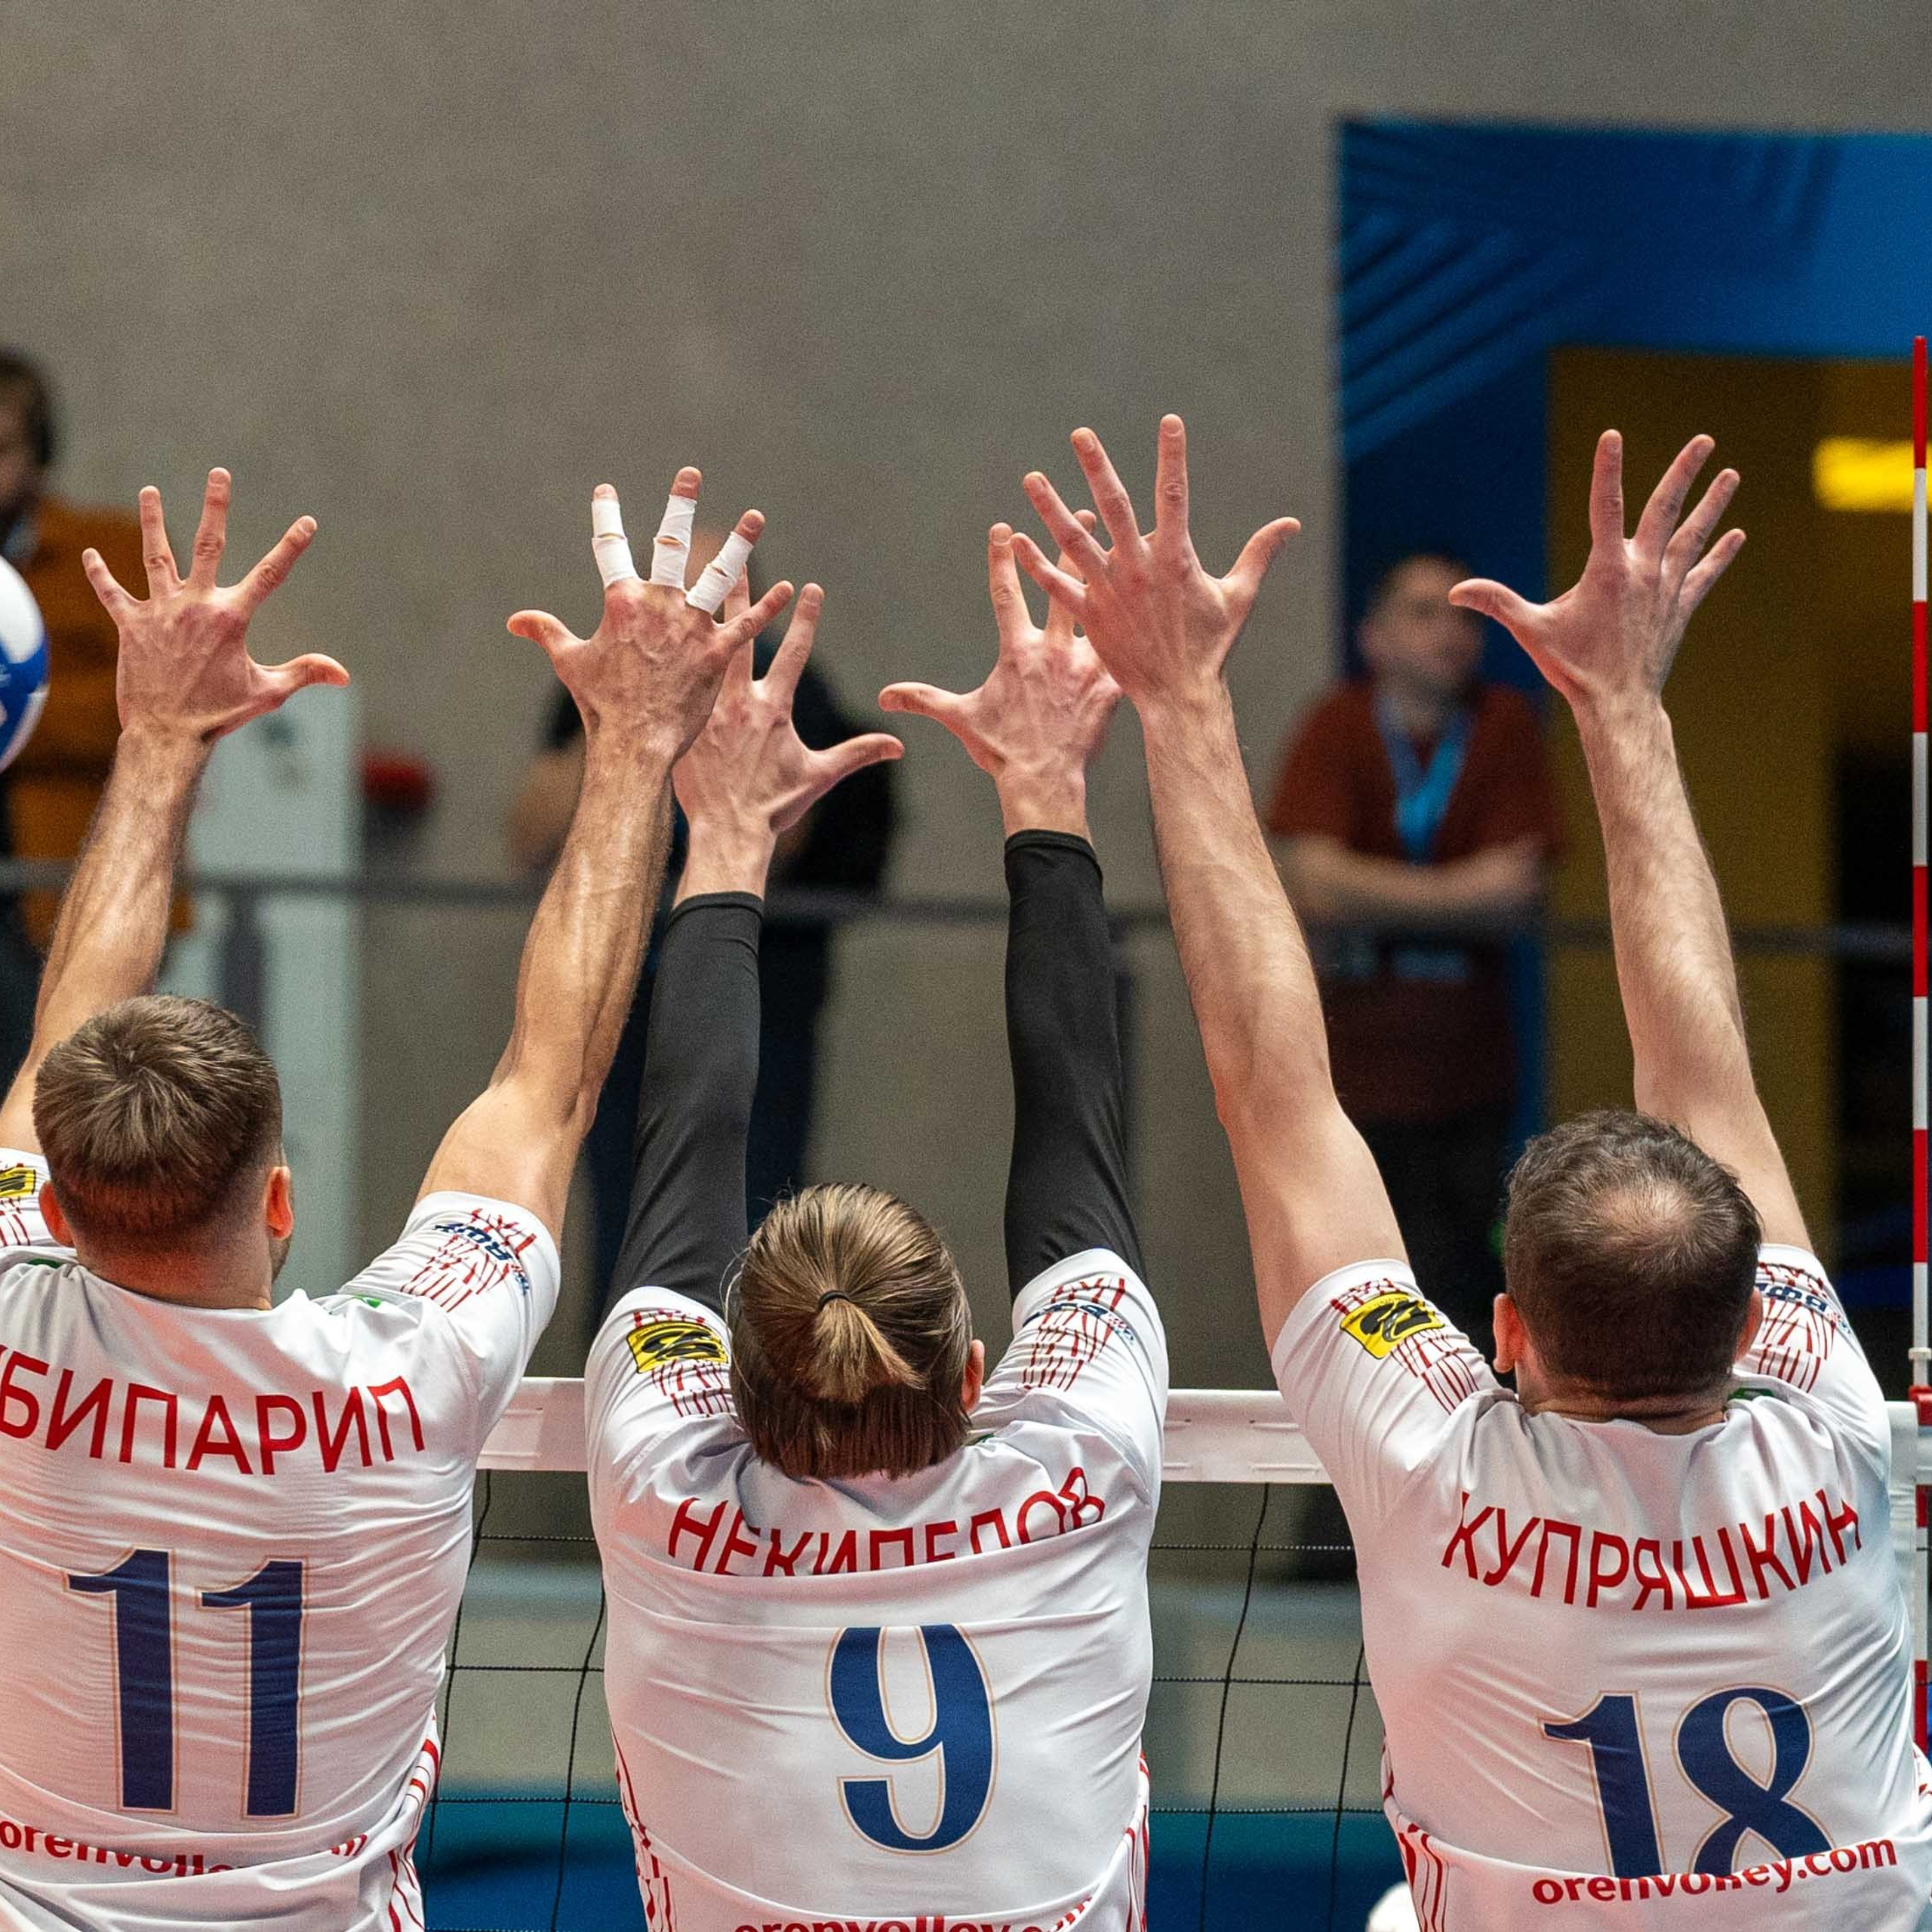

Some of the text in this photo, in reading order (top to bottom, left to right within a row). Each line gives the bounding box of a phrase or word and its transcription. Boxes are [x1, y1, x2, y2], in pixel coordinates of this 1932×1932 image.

[0, 1346, 425, 1475] БИПАРИП
[1441, 1491, 1862, 1611] КУПРЯШКИН
[62, 1546, 308, 1820] 11
[825, 1623, 1001, 1857] 9
[1537, 1682, 1835, 1879] 18
[1532, 1838, 1897, 1905] orenvoey.com
